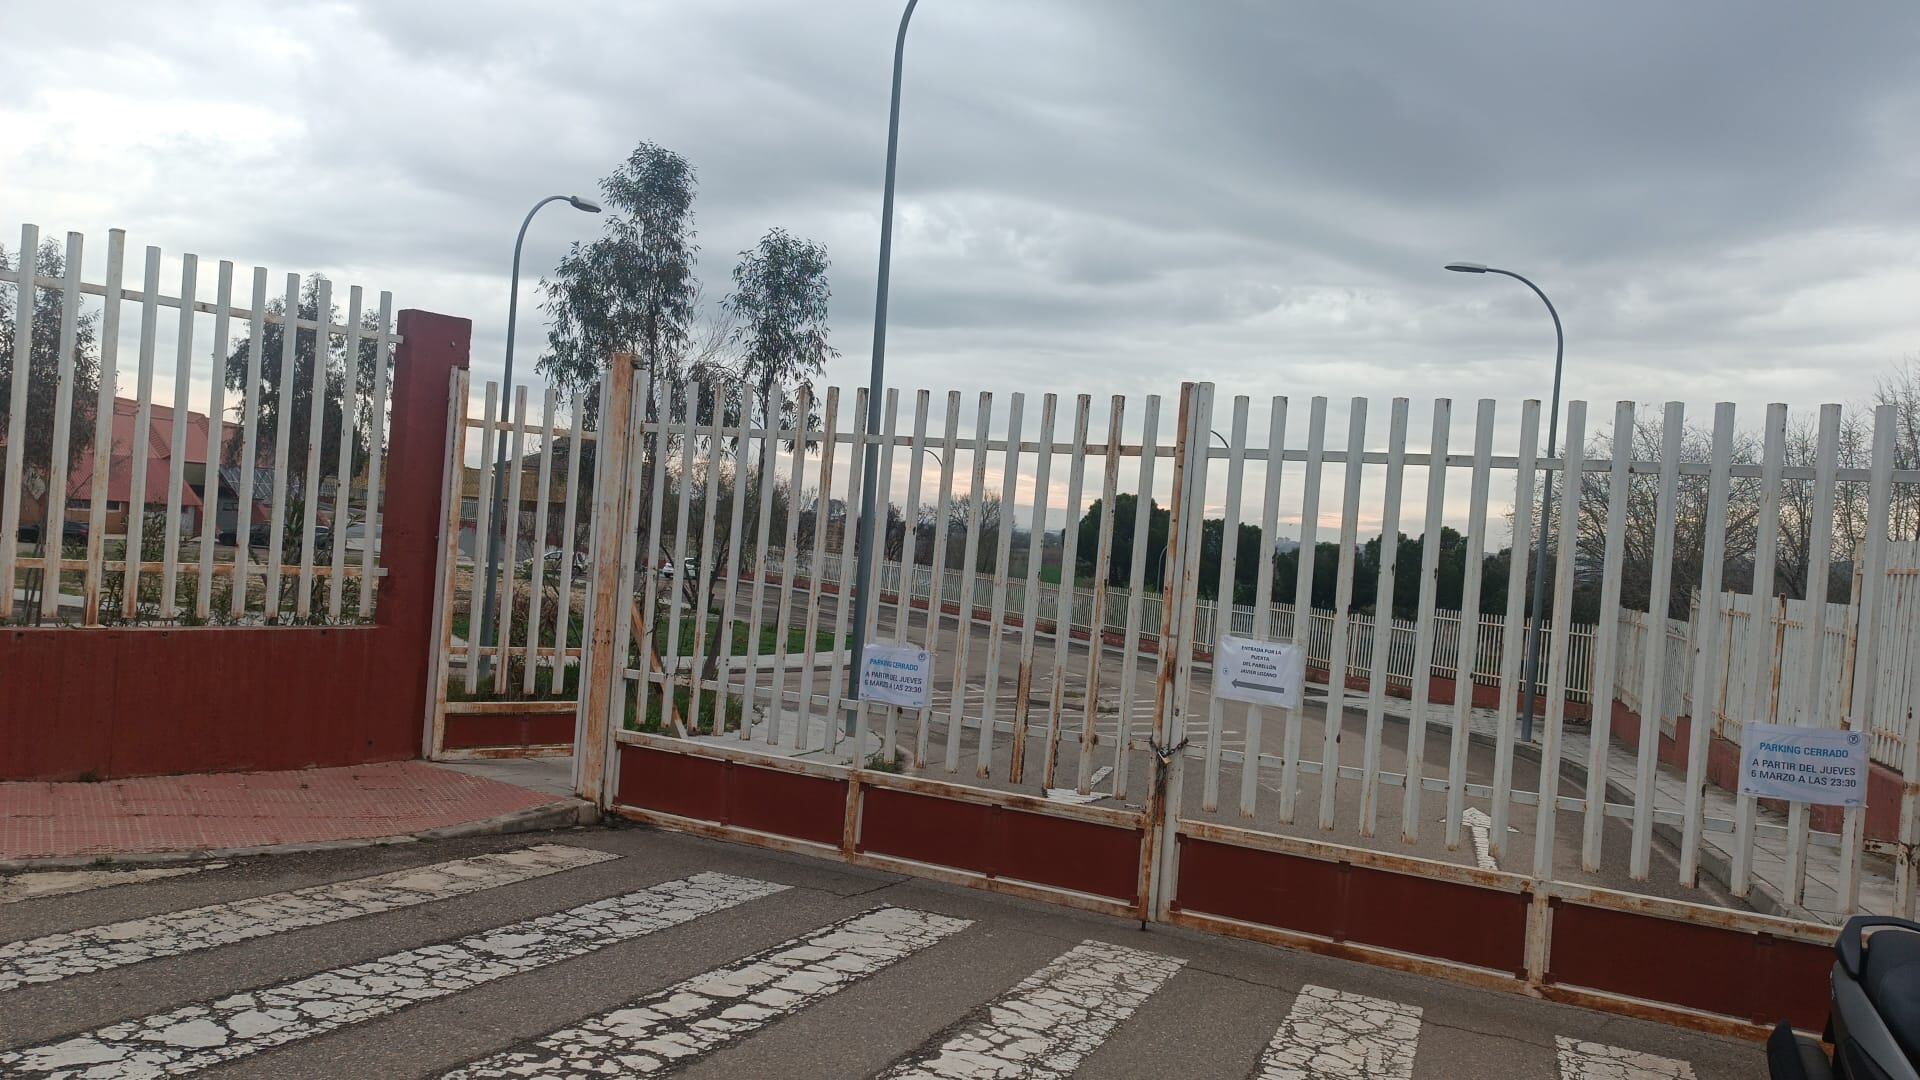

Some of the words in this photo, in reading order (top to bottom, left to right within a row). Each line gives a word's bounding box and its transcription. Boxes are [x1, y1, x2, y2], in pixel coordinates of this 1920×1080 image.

[1241, 645, 1264, 653] ENTRADA
[869, 658, 892, 668] PARKING
[892, 661, 919, 671] CERRADO
[1250, 654, 1270, 662] PUERTA
[871, 671, 889, 680] PARTIR
[889, 674, 897, 682] DEL
[899, 676, 923, 685] JUEVES
[893, 683, 903, 691] LAS
[904, 685, 922, 693] 23:30
[1759, 742, 1801, 755] PARKING
[1803, 747, 1849, 758] CERRADO
[1752, 758, 1760, 766] A
[1762, 760, 1796, 771] PARTIR
[1799, 763, 1817, 774] DEL
[1820, 765, 1856, 776] JUEVES
[1759, 770, 1796, 782] MARZO
[1798, 775, 1806, 784] A
[1808, 776, 1828, 786] LAS
[1830, 778, 1857, 788] 23:30
